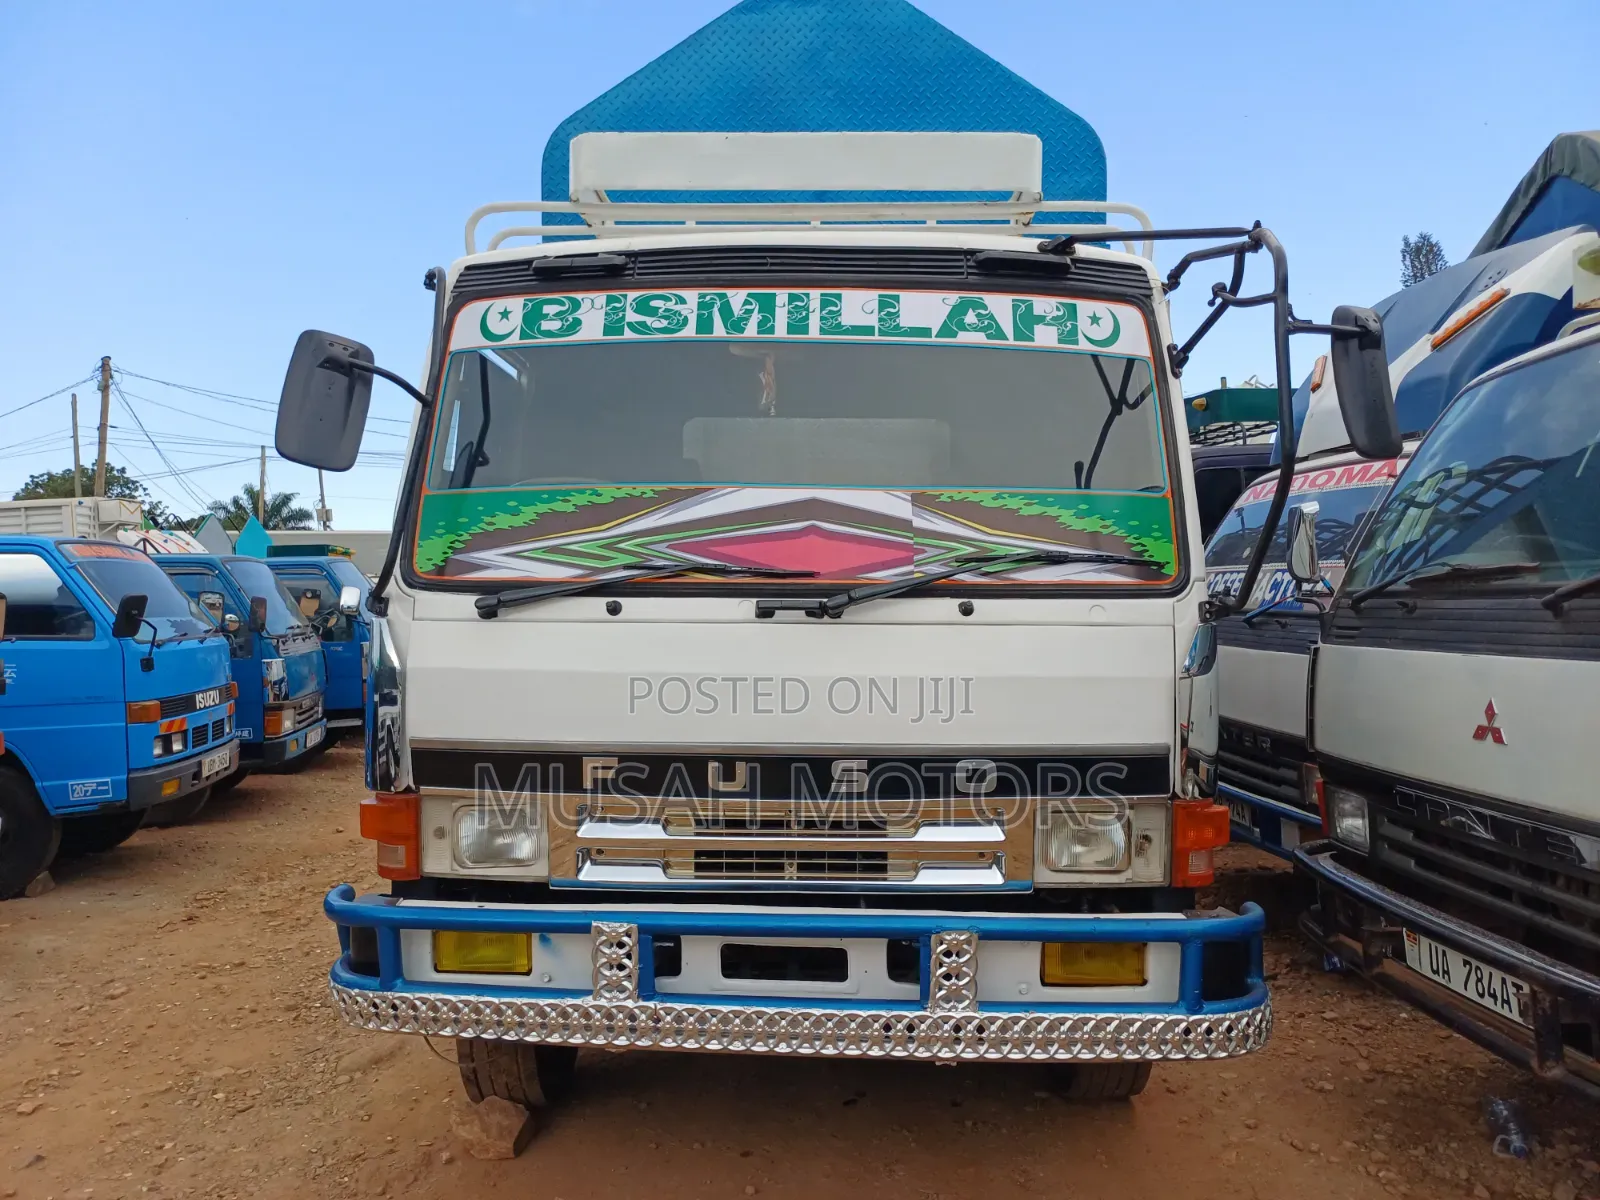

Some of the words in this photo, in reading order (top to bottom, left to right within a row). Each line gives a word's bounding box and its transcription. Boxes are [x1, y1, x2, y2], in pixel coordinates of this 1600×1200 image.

[519, 292, 1079, 345] BISMILLAH
[1205, 571, 1245, 597] COFFE
[195, 689, 220, 709] ISUZU
[582, 757, 998, 793] FUSO
[1429, 942, 1452, 984] UA
[1462, 958, 1525, 1019] 784AT
